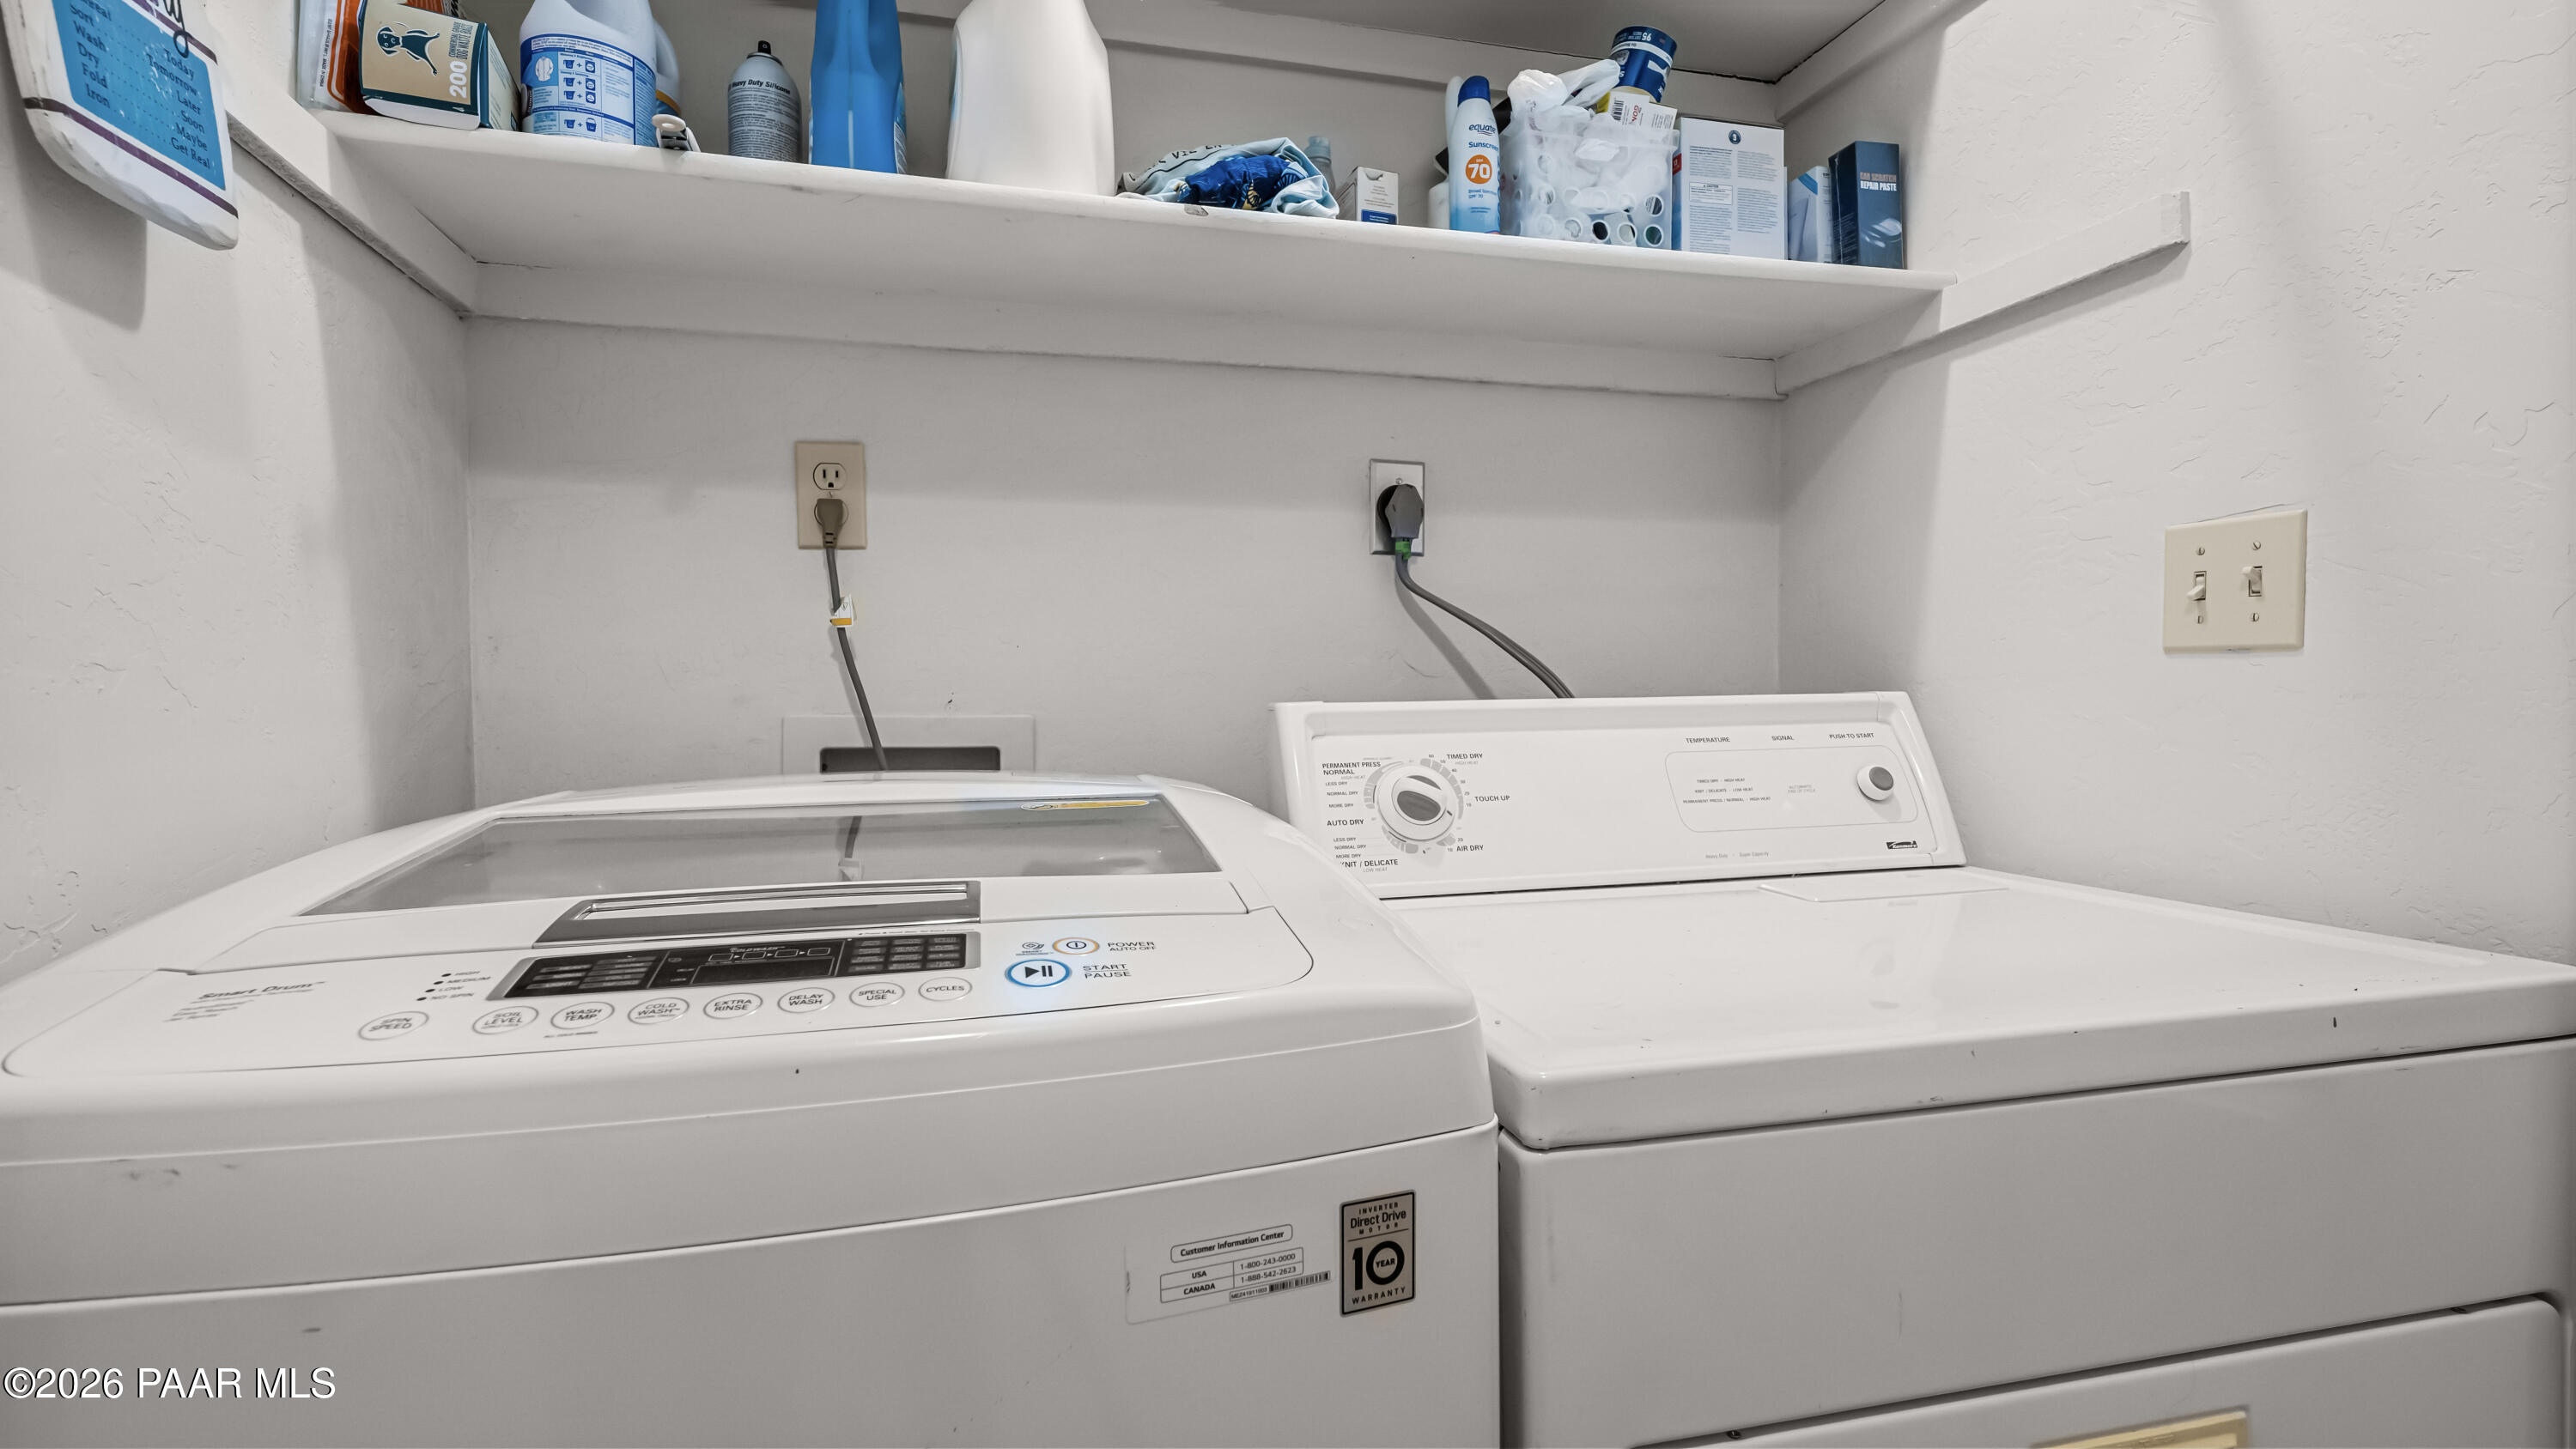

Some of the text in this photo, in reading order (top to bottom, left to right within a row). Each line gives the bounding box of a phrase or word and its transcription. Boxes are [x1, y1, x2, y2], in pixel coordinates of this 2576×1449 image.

[1641, 32, 1652, 41] 95
[73, 20, 201, 115] Wash Later
[164, 47, 195, 81] Today
[146, 53, 197, 96] Tomorrow
[448, 60, 469, 99] 200
[76, 41, 205, 134] Dry Soon
[765, 82, 791, 95] Silicone
[82, 62, 208, 152] Fold Maybe
[85, 82, 210, 170] Iron Get Real
[1468, 124, 1496, 134] equate
[1467, 163, 1492, 179] 70
[1860, 180, 1897, 191] REPAIR PASTE
[1892, 841, 1918, 850] Kenmore
[1364, 858, 1399, 867] DELICATE
[197, 988, 258, 999] Smart
[714, 1003, 750, 1012] RINSE
[789, 997, 823, 1006] WASH
[368, 1022, 412, 1032] SPEED
[484, 1016, 523, 1026] LEVEL
[1358, 1202, 1399, 1215] INVERTER
[1350, 1210, 1407, 1229] Direct Drive
[1358, 1222, 1399, 1235] MOTOR
[1180, 1230, 1285, 1258] Customer Information Center
[1191, 1253, 1296, 1279] USA 1-800-243-0000
[1352, 1240, 1406, 1291] 10
[1376, 1256, 1395, 1268] YEAR
[1183, 1266, 1297, 1295] CANADA 1-888-542-2623
[1352, 1286, 1406, 1305] WARRANTY
